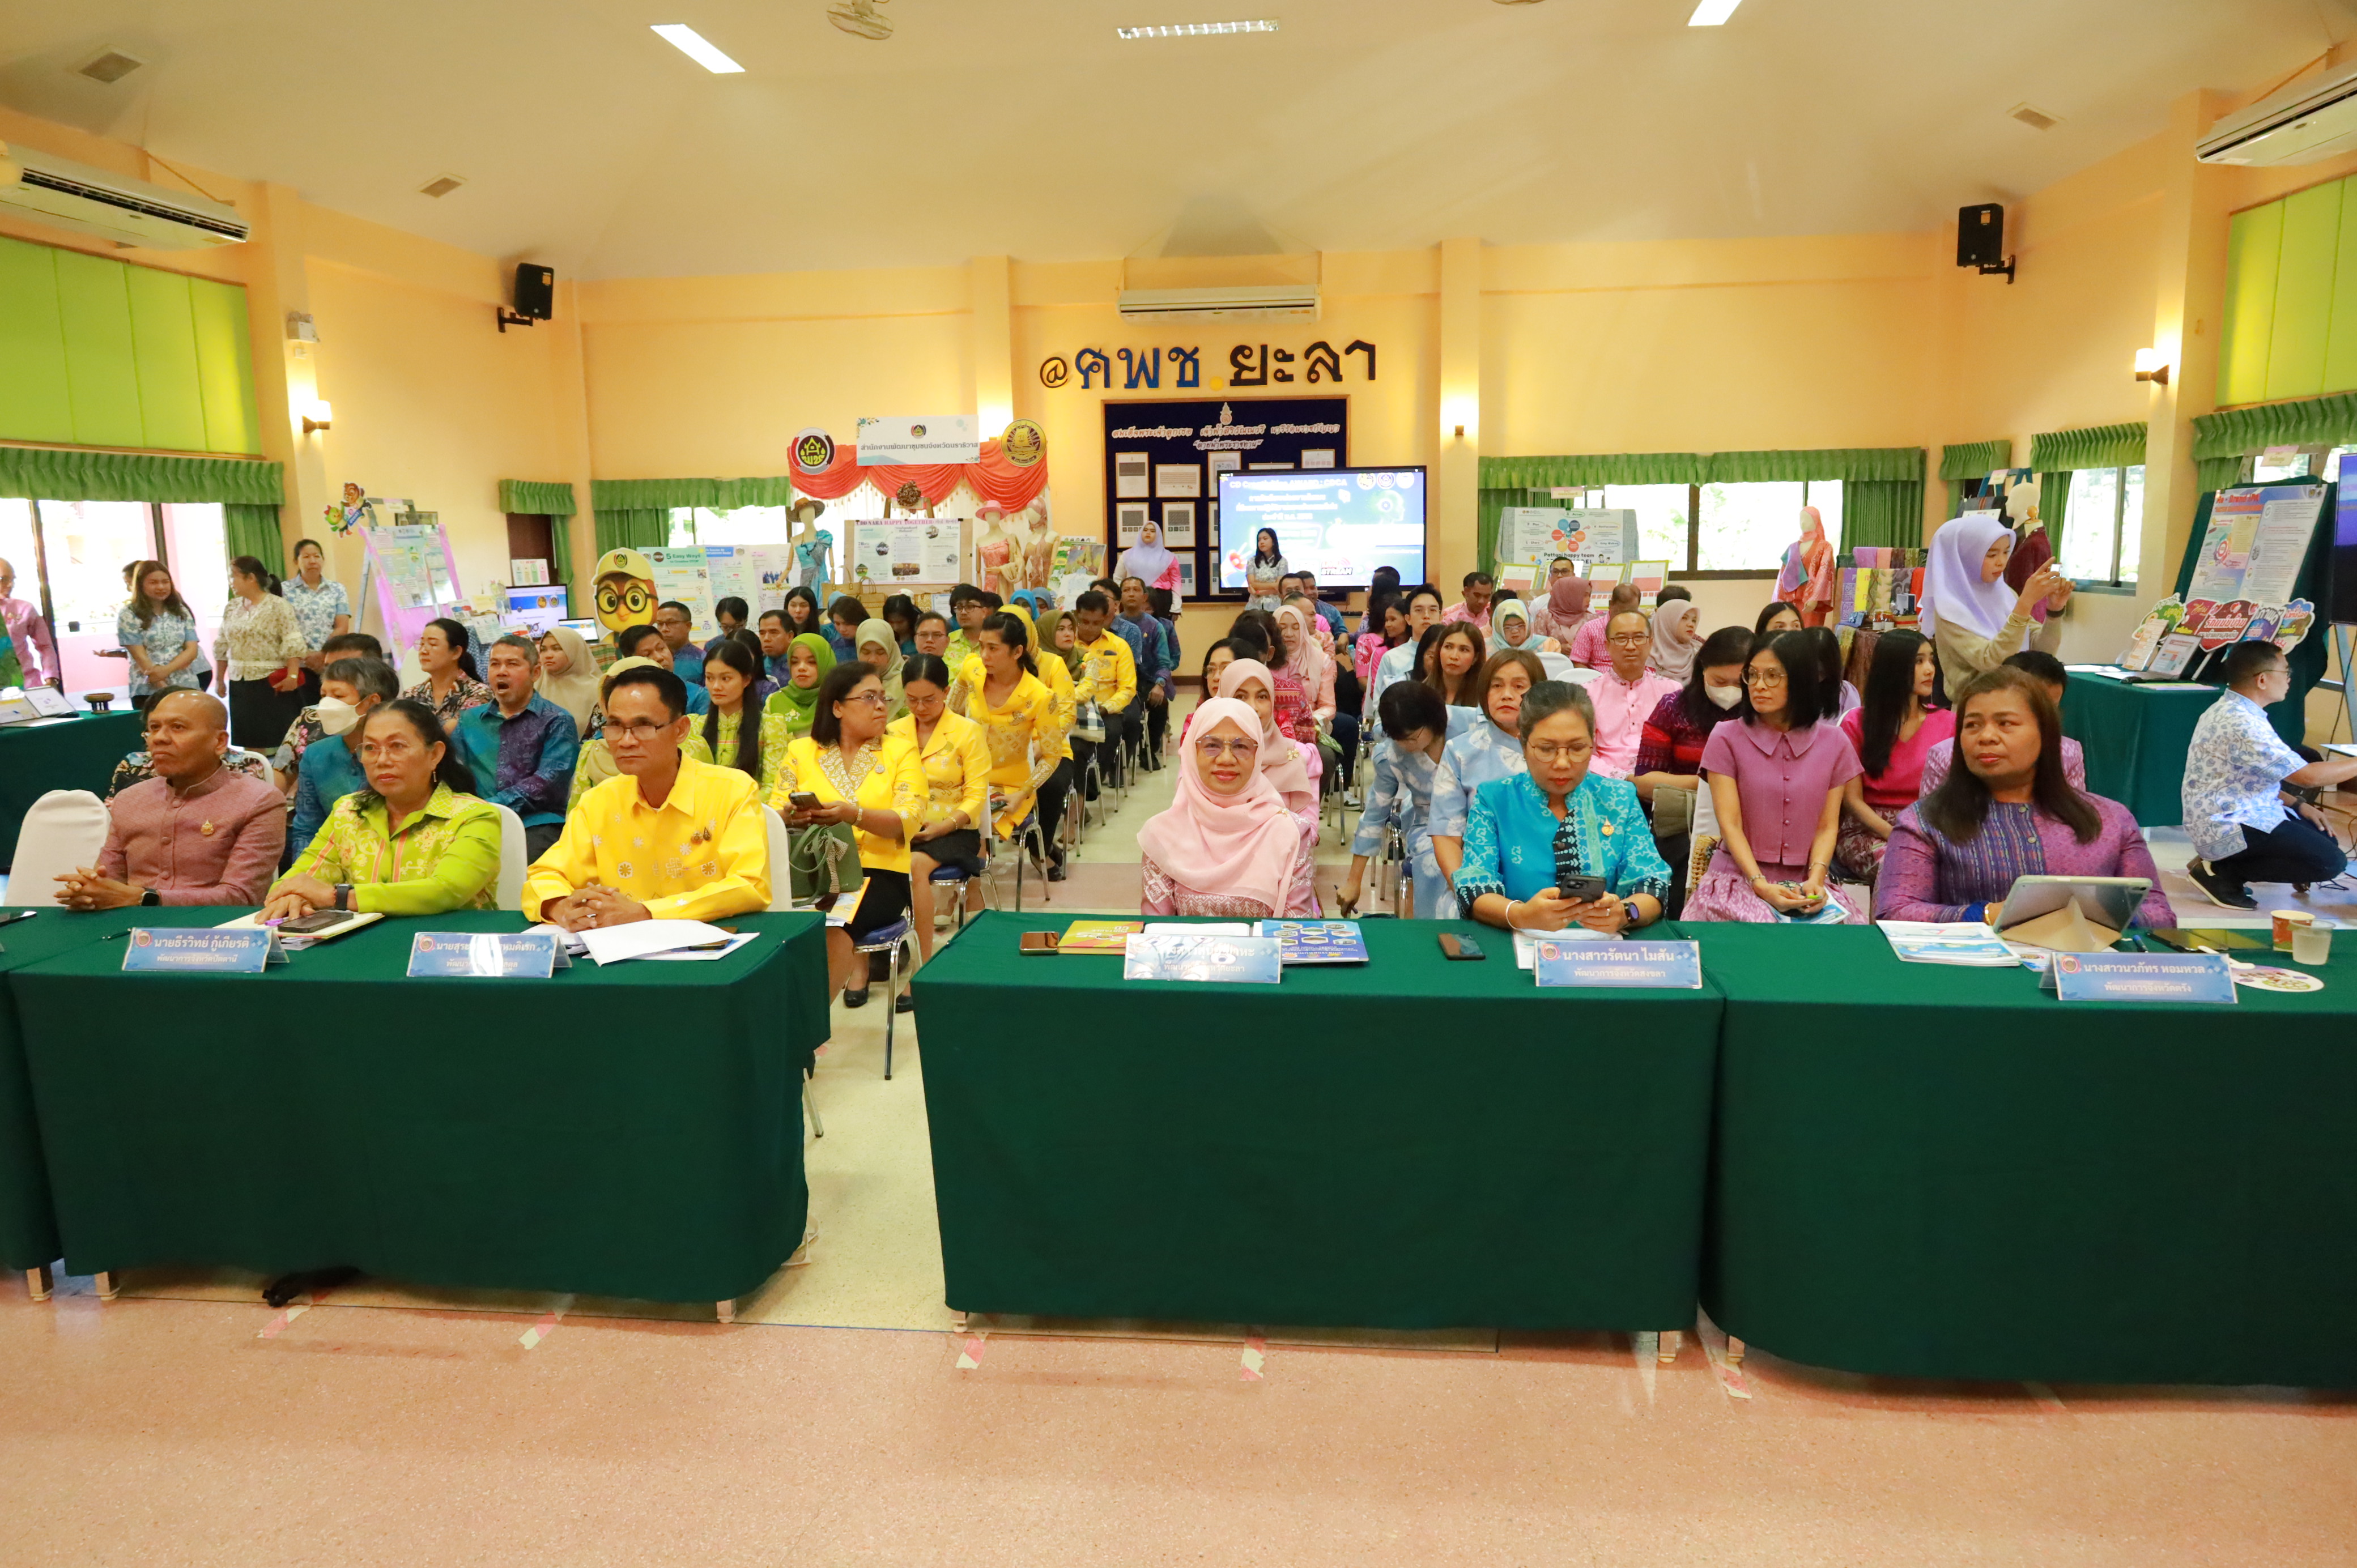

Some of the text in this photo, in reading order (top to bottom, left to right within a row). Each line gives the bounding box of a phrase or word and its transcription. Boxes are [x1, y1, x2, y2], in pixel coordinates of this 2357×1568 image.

[1112, 426, 1193, 440] สมเด็จพระเจ้าลูกเธอ
[861, 441, 978, 452] สำนักงานพัฒนาชุมชนจังหวัดนราธิวาส
[1321, 567, 1353, 576] STREAM
[154, 934, 209, 948] นายธีรวิทย์
[157, 954, 239, 964] พัฒนาการจังหวัดปัตตานี
[1563, 947, 1675, 962] นางสาวรัตนา ไมสัน
[1573, 968, 1666, 978] พัฒนาการจังหวัดสงขลา
[2083, 961, 2206, 975] นางสาวนวภัทร หอมหวล
[2104, 982, 2192, 994] พัฒนาการจังหวัดตรัง
